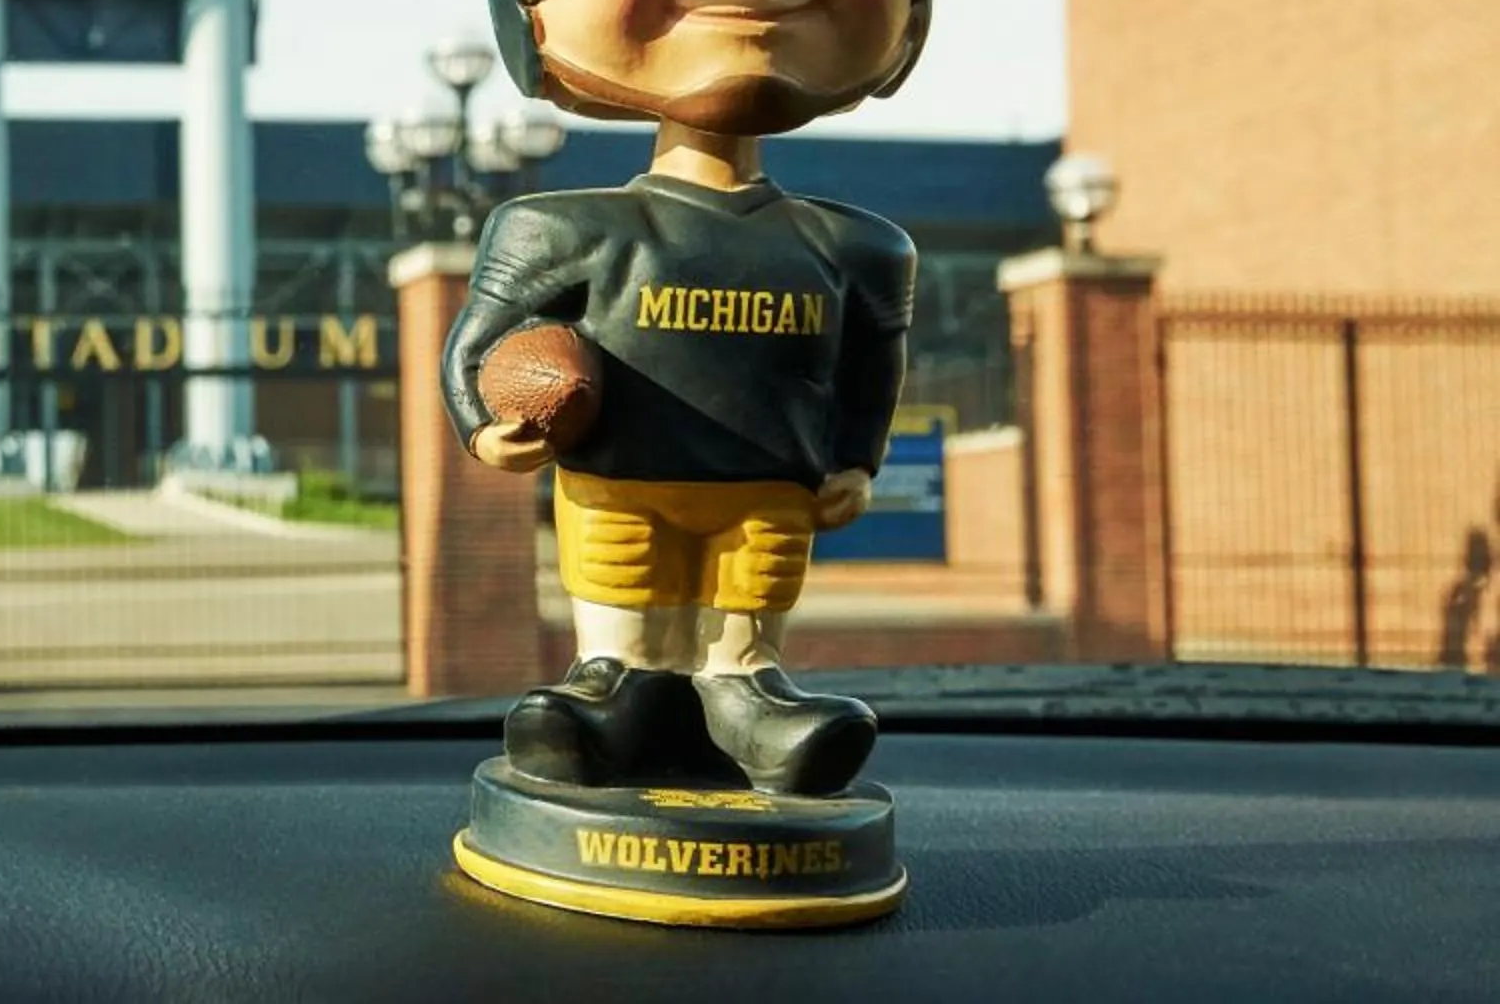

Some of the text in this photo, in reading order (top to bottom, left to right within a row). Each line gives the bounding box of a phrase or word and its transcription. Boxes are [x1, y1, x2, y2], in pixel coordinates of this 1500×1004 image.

[636, 285, 825, 335] MICHIGAN
[14, 316, 378, 371] TADUM
[576, 828, 843, 878] WOLVERINES
